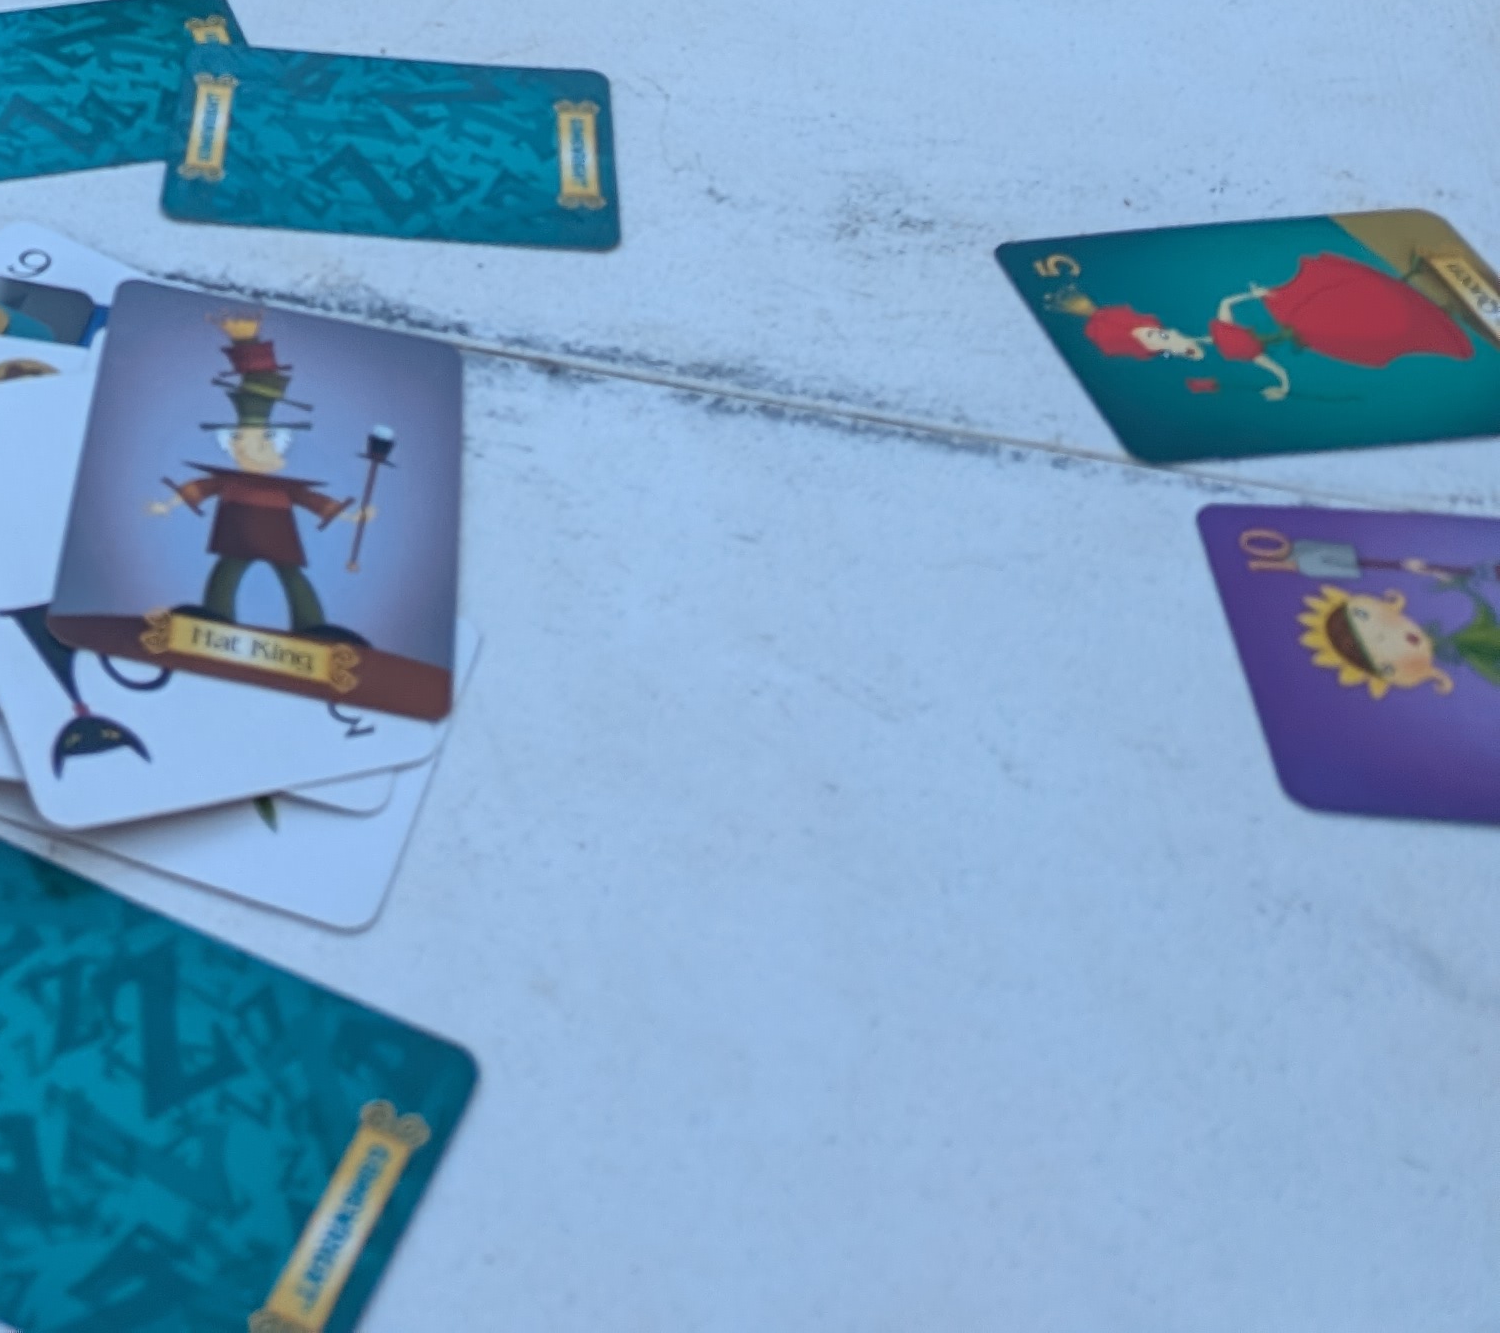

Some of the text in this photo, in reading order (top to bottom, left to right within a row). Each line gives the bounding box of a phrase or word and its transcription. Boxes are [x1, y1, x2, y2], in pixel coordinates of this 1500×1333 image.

[1033, 254, 1081, 277] 5
[190, 626, 314, 675] Hat King
